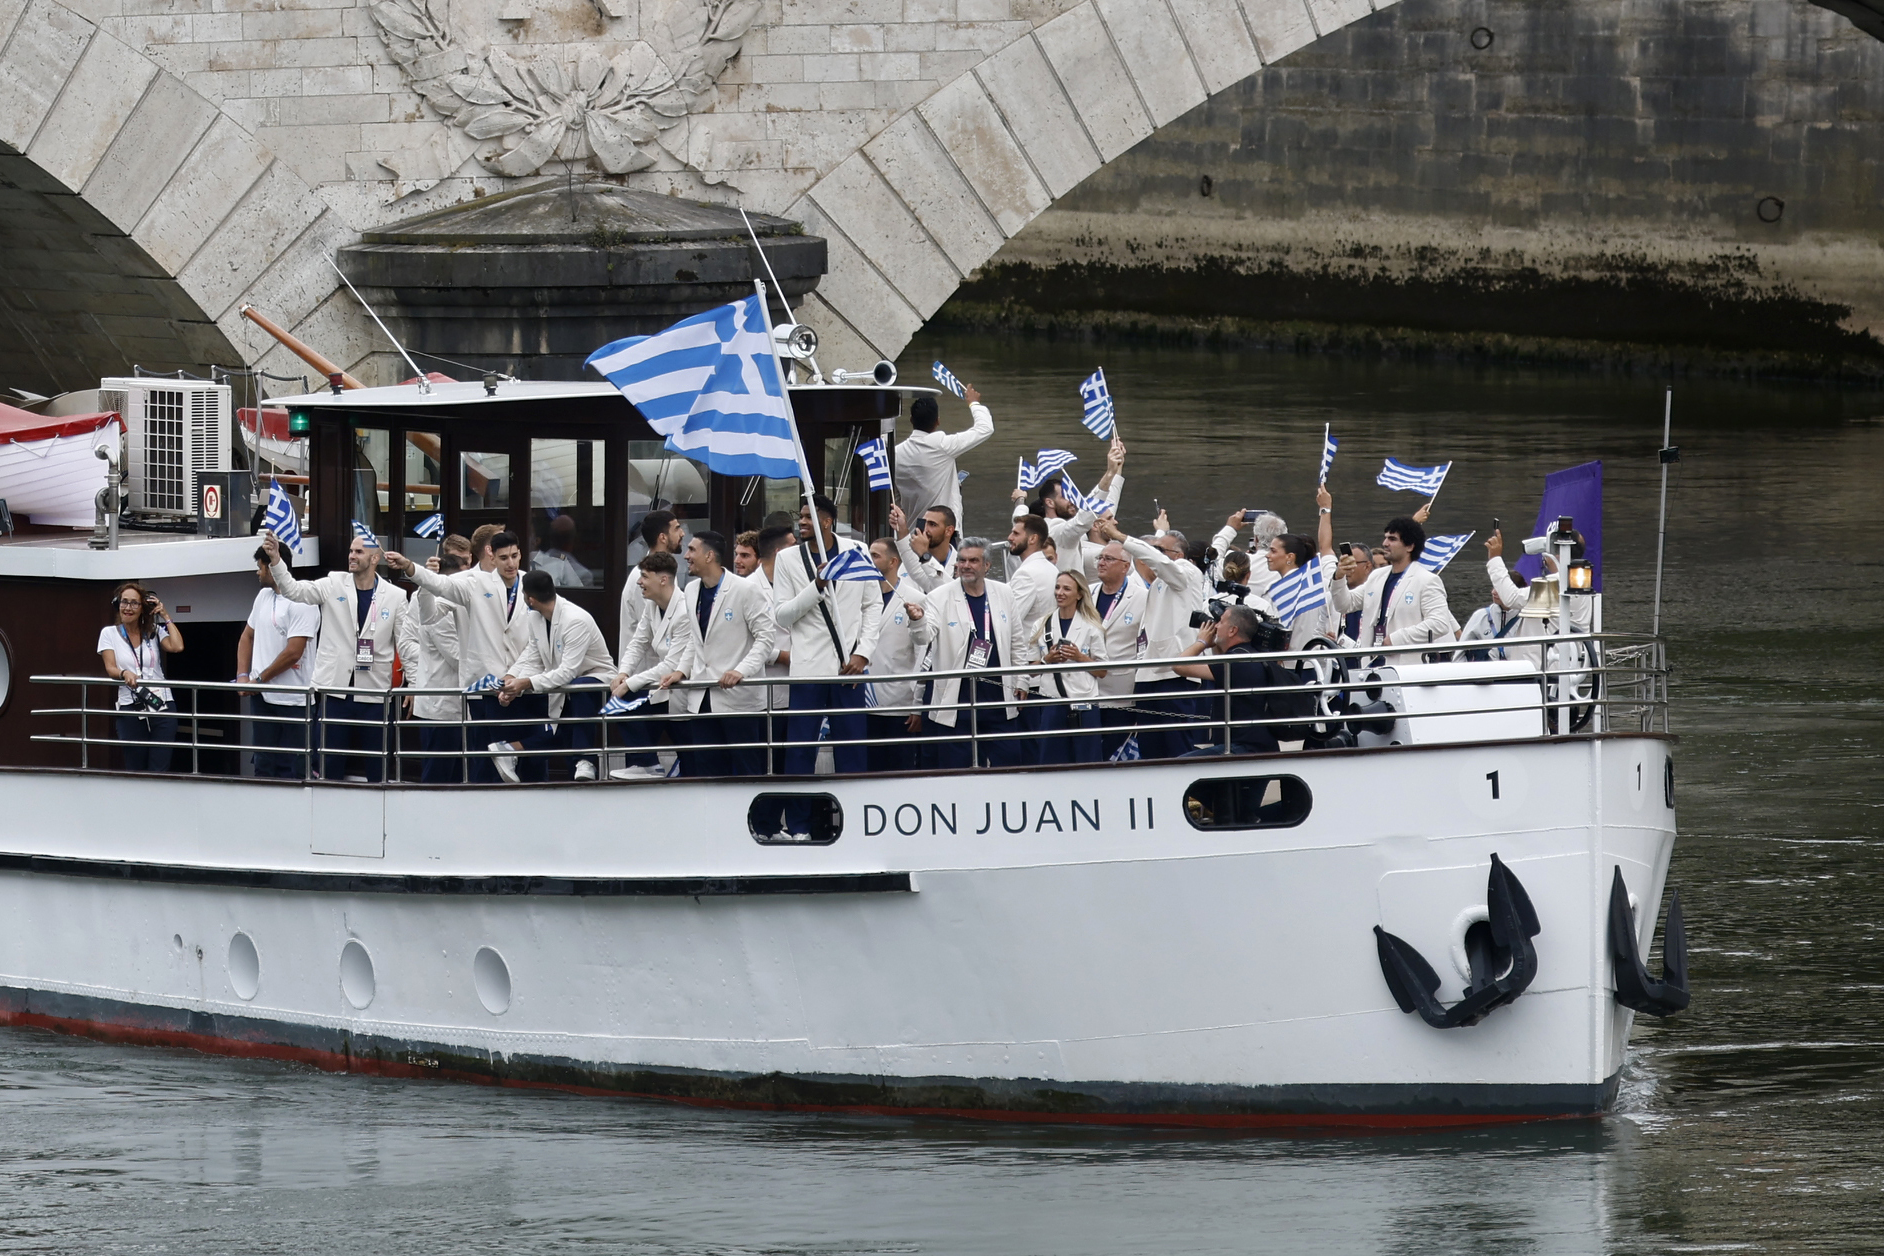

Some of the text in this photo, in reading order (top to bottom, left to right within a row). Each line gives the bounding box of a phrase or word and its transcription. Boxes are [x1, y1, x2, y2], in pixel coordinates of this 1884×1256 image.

[1485, 770, 1500, 800] 1
[1636, 761, 1642, 792] 1
[863, 797, 1154, 837] DON JUAN II
